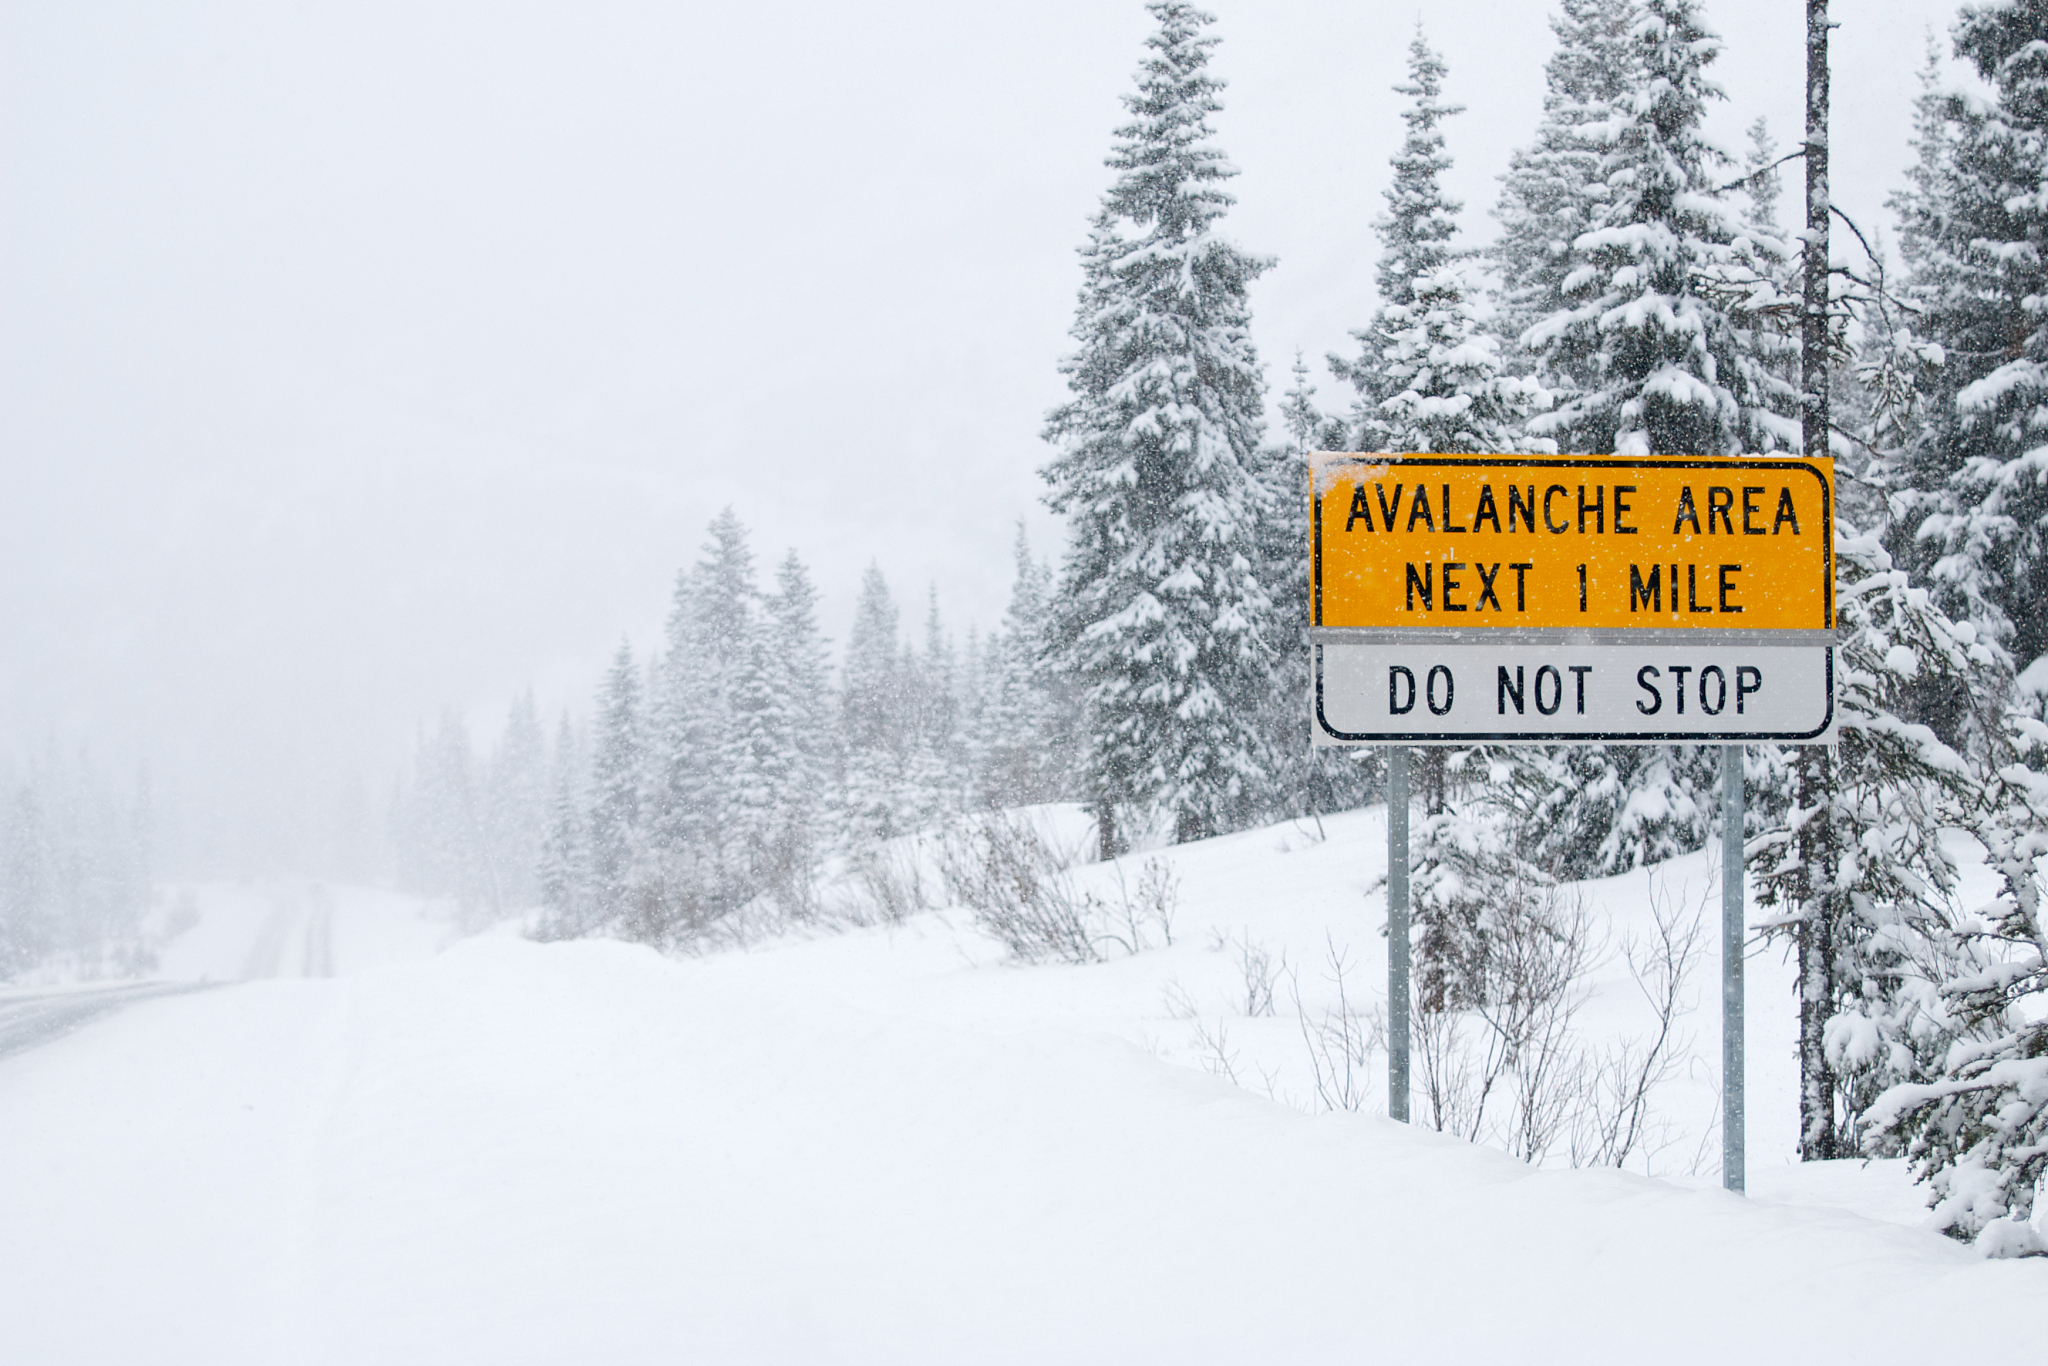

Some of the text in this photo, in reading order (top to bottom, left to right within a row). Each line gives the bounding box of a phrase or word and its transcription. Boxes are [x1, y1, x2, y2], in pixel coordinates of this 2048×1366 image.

[1345, 483, 1801, 536] AVALANCHE AREA
[1405, 562, 1744, 614] NEXT 1 MILE
[1388, 664, 1763, 716] DO NOT STOP
